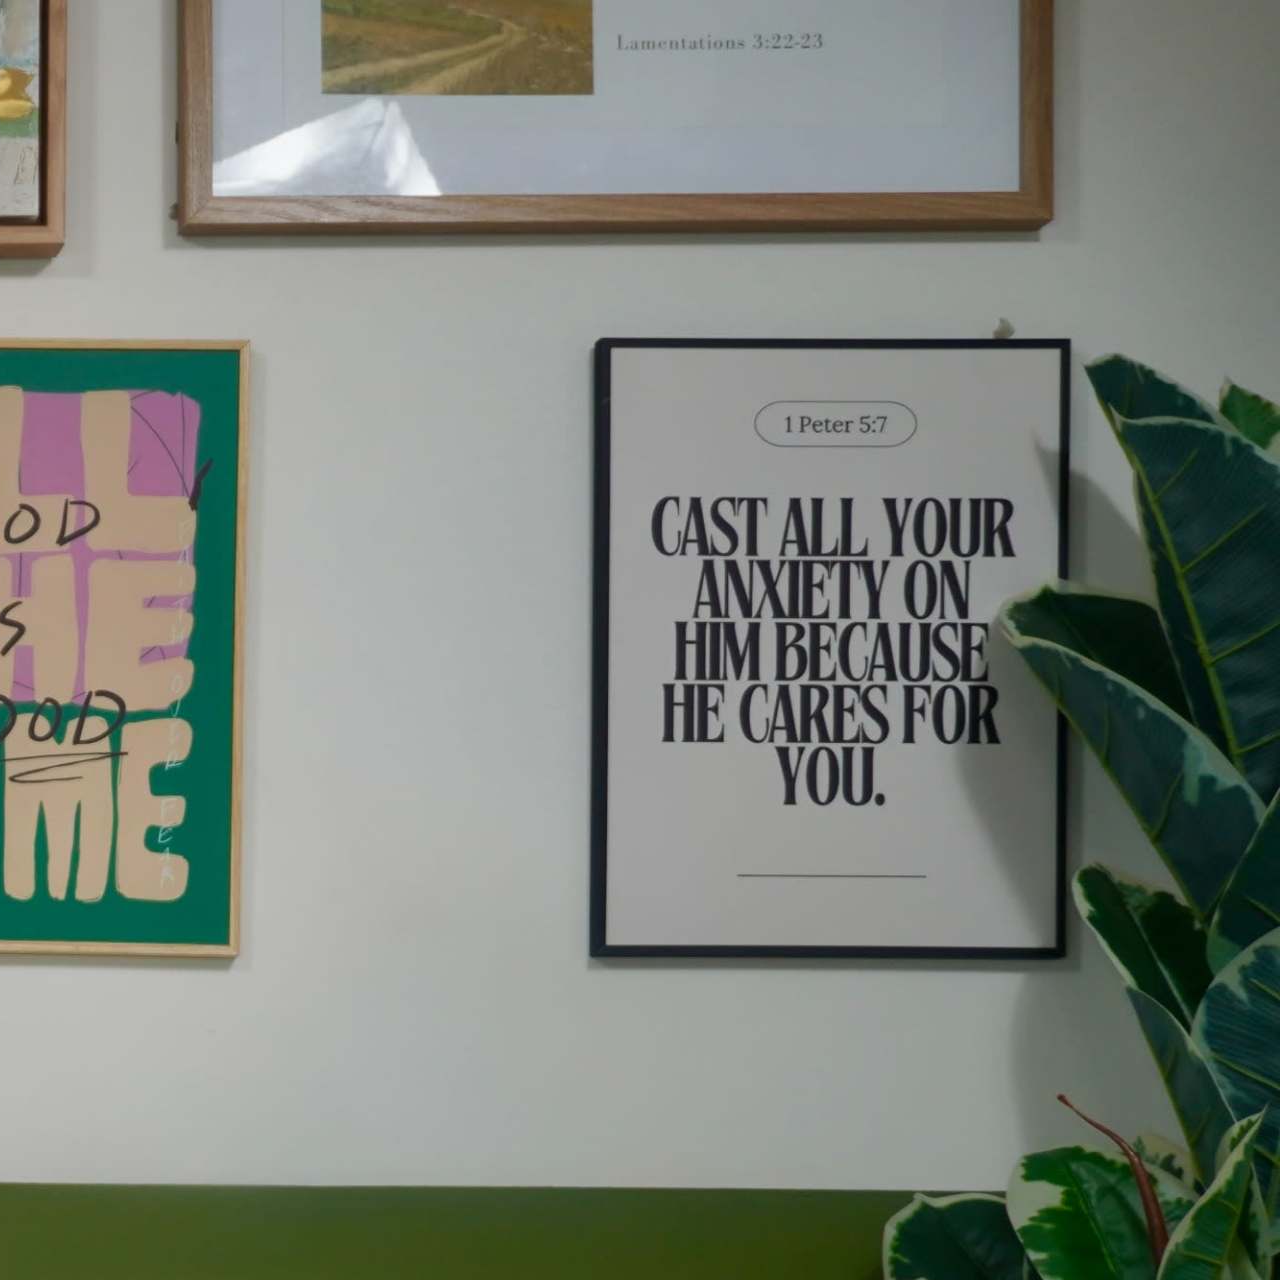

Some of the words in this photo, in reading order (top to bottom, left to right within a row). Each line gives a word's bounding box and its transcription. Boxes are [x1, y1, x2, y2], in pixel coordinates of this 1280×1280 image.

[616, 33, 746, 50] Lamentations
[752, 32, 824, 50] 3:22-23
[783, 414, 794, 434] 1
[799, 414, 855, 435] Peter
[858, 414, 889, 435] 5:7
[650, 495, 768, 558] CAST
[779, 496, 869, 558] ALL
[881, 496, 1017, 559] YOUR
[691, 559, 892, 620] ANXIETY
[903, 559, 973, 621] ON
[673, 621, 762, 682] HIM
[775, 621, 992, 683] BECAUSE
[661, 683, 726, 744] HE
[738, 683, 891, 745] CARES
[901, 684, 1003, 746] FOR
[775, 745, 888, 808] YOU.
